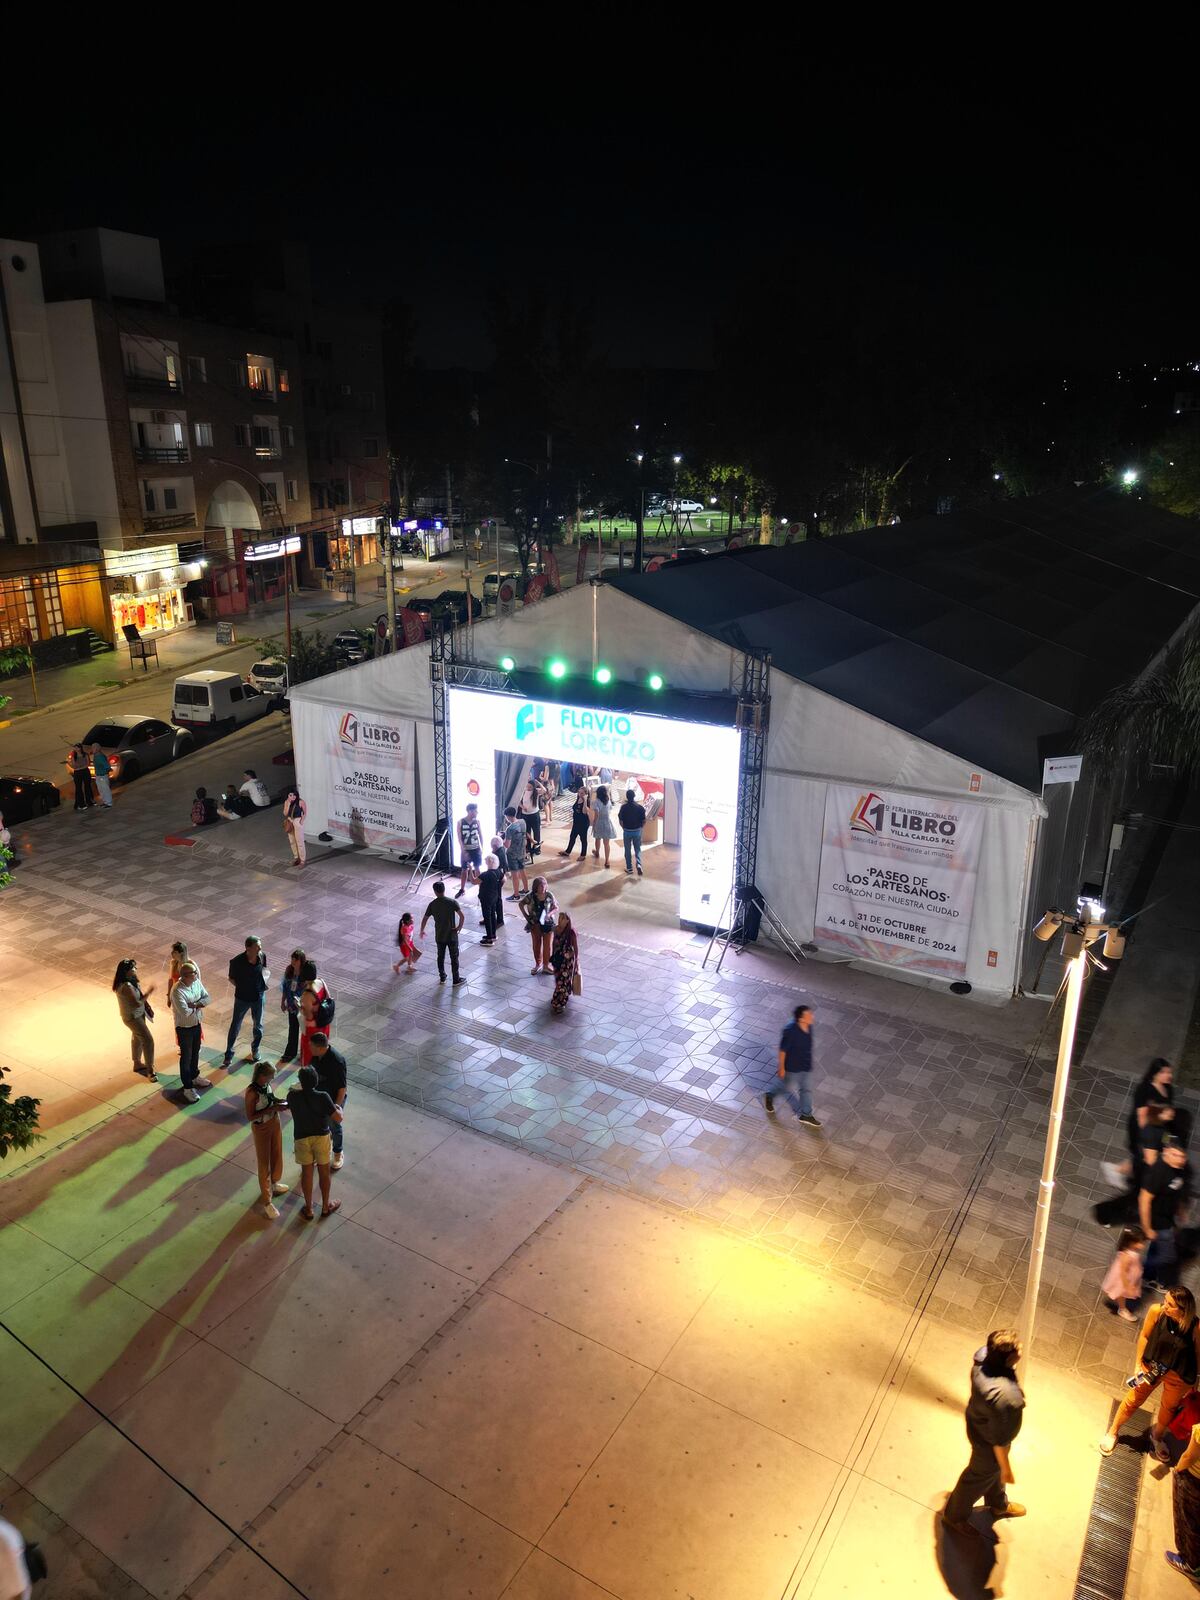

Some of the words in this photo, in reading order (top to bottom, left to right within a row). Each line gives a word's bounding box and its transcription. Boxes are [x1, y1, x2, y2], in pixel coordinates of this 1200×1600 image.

[561, 709, 631, 736] FLAVIO
[363, 727, 400, 743] LIBRO
[343, 776, 357, 785] LOS
[368, 792, 390, 801] NUESTRA
[369, 810, 393, 820] OCTUBRE
[892, 806, 906, 814] FERIA
[906, 807, 947, 820] INTERNACIONAL
[891, 812, 955, 836] LIBRO
[891, 829, 909, 838] VILLA
[911, 834, 939, 843] CARLOS
[931, 851, 953, 859] mundo
[847, 874, 868, 886] LOS
[913, 877, 928, 887] DE
[833, 883, 872, 898] CORAZÓN
[875, 893, 885, 901] DE
[888, 895, 924, 911] NUESTRA
[927, 904, 959, 918] CIUDAD
[857, 913, 867, 921] 31
[870, 915, 881, 924] DE
[884, 918, 927, 934] OCTUBRE
[827, 916, 838, 924] AL
[849, 921, 859, 929] DE
[861, 924, 916, 943] NOVIEMBRE
[918, 937, 929, 946] DE
[932, 941, 957, 952] 2024
